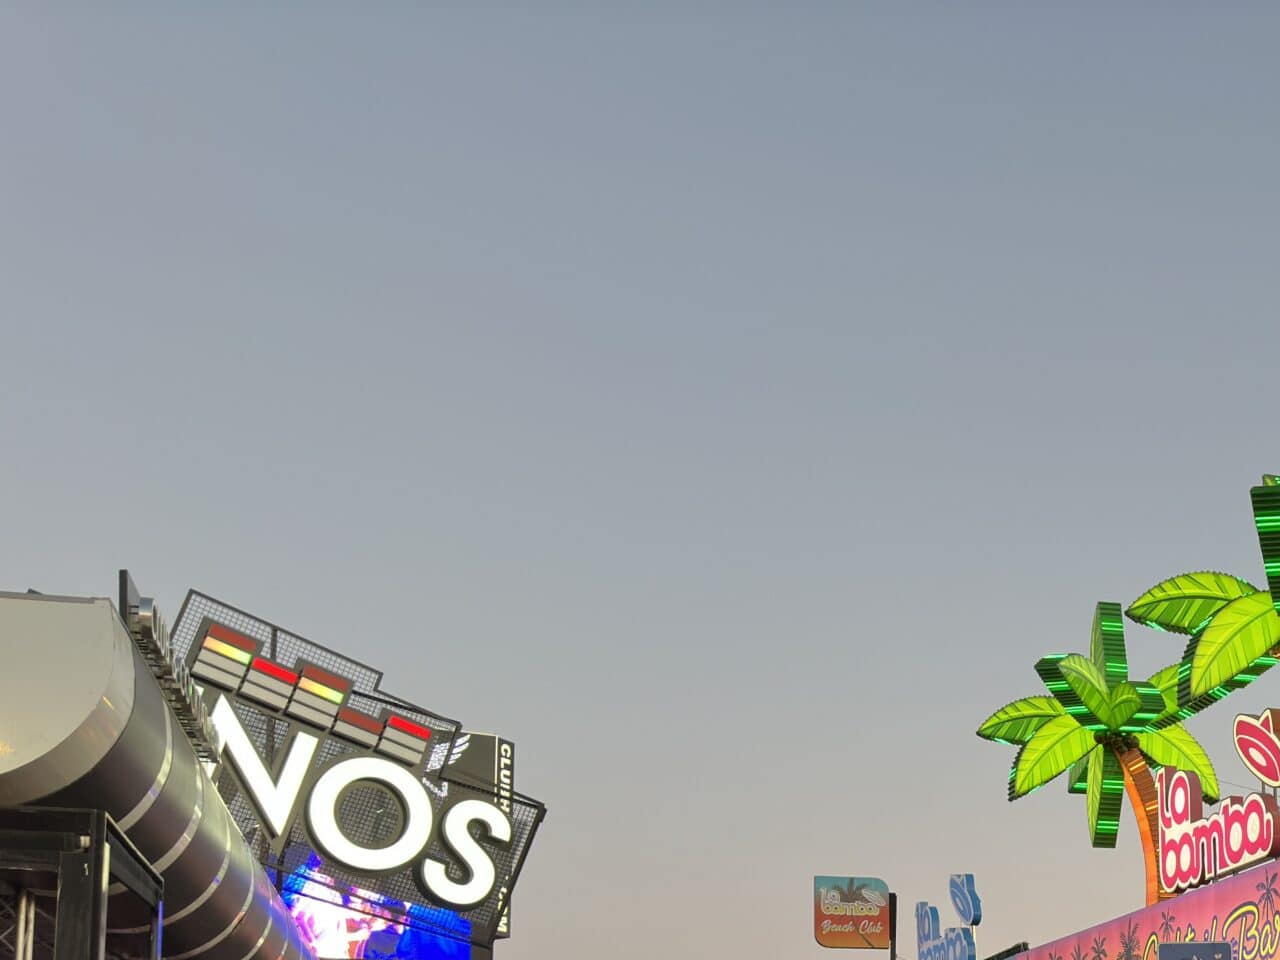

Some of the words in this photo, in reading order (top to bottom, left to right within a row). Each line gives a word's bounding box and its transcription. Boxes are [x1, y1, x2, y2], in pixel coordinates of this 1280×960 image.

[1157, 772, 1191, 829] la
[1160, 798, 1274, 891] bamba
[821, 919, 855, 934] Beach
[858, 919, 884, 935] Club
